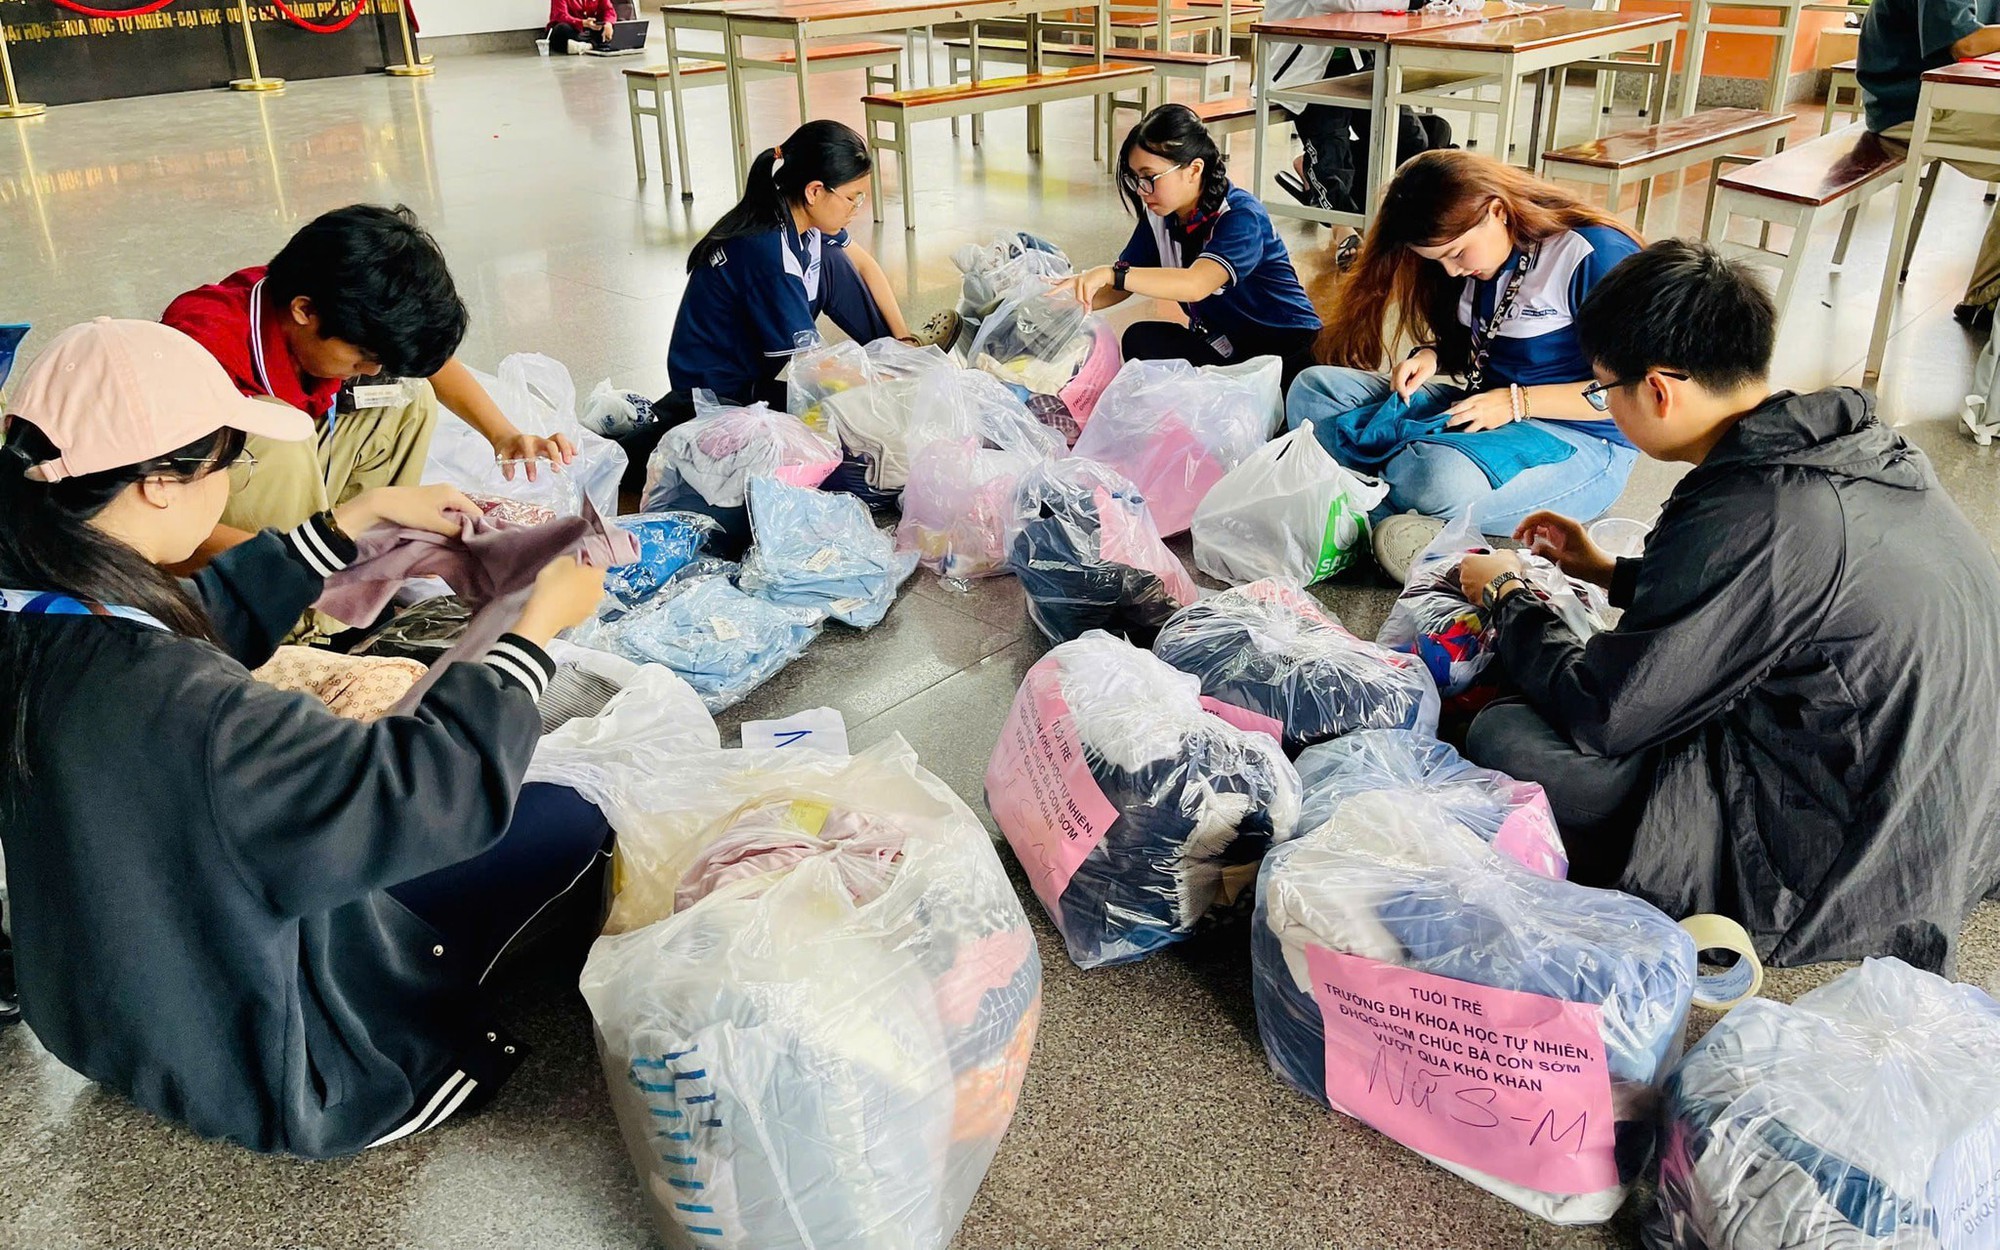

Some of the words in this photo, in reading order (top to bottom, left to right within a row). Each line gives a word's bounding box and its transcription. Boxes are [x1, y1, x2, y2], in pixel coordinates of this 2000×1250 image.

[89, 17, 115, 36] HỌC
[1038, 732, 1053, 762] KHOA
[1066, 798, 1093, 838] NHIÊN,
[1048, 789, 1061, 815] CON
[1058, 812, 1078, 841] SỚM
[1324, 983, 1385, 1013] TRƯỜNG
[1389, 1004, 1411, 1020] ĐH
[1415, 1011, 1460, 1034] KHOA
[1464, 1024, 1498, 1044] HỌC
[1503, 1034, 1529, 1053] TỰ
[1533, 1039, 1594, 1061] NHIÊN,
[1409, 986, 1447, 1006] TUỔI
[1452, 996, 1483, 1016] TRẺ
[1339, 1003, 1415, 1041] ĐHQG-HCM
[1419, 1033, 1463, 1055] CHÚC
[1496, 1054, 1533, 1070] CON
[1539, 1060, 1581, 1073] SỚM
[1373, 1031, 1413, 1055] VƯỢT
[1418, 1050, 1450, 1071] QUA
[1453, 1061, 1489, 1081] KHÓ
[1493, 1072, 1542, 1092] KHĂN
